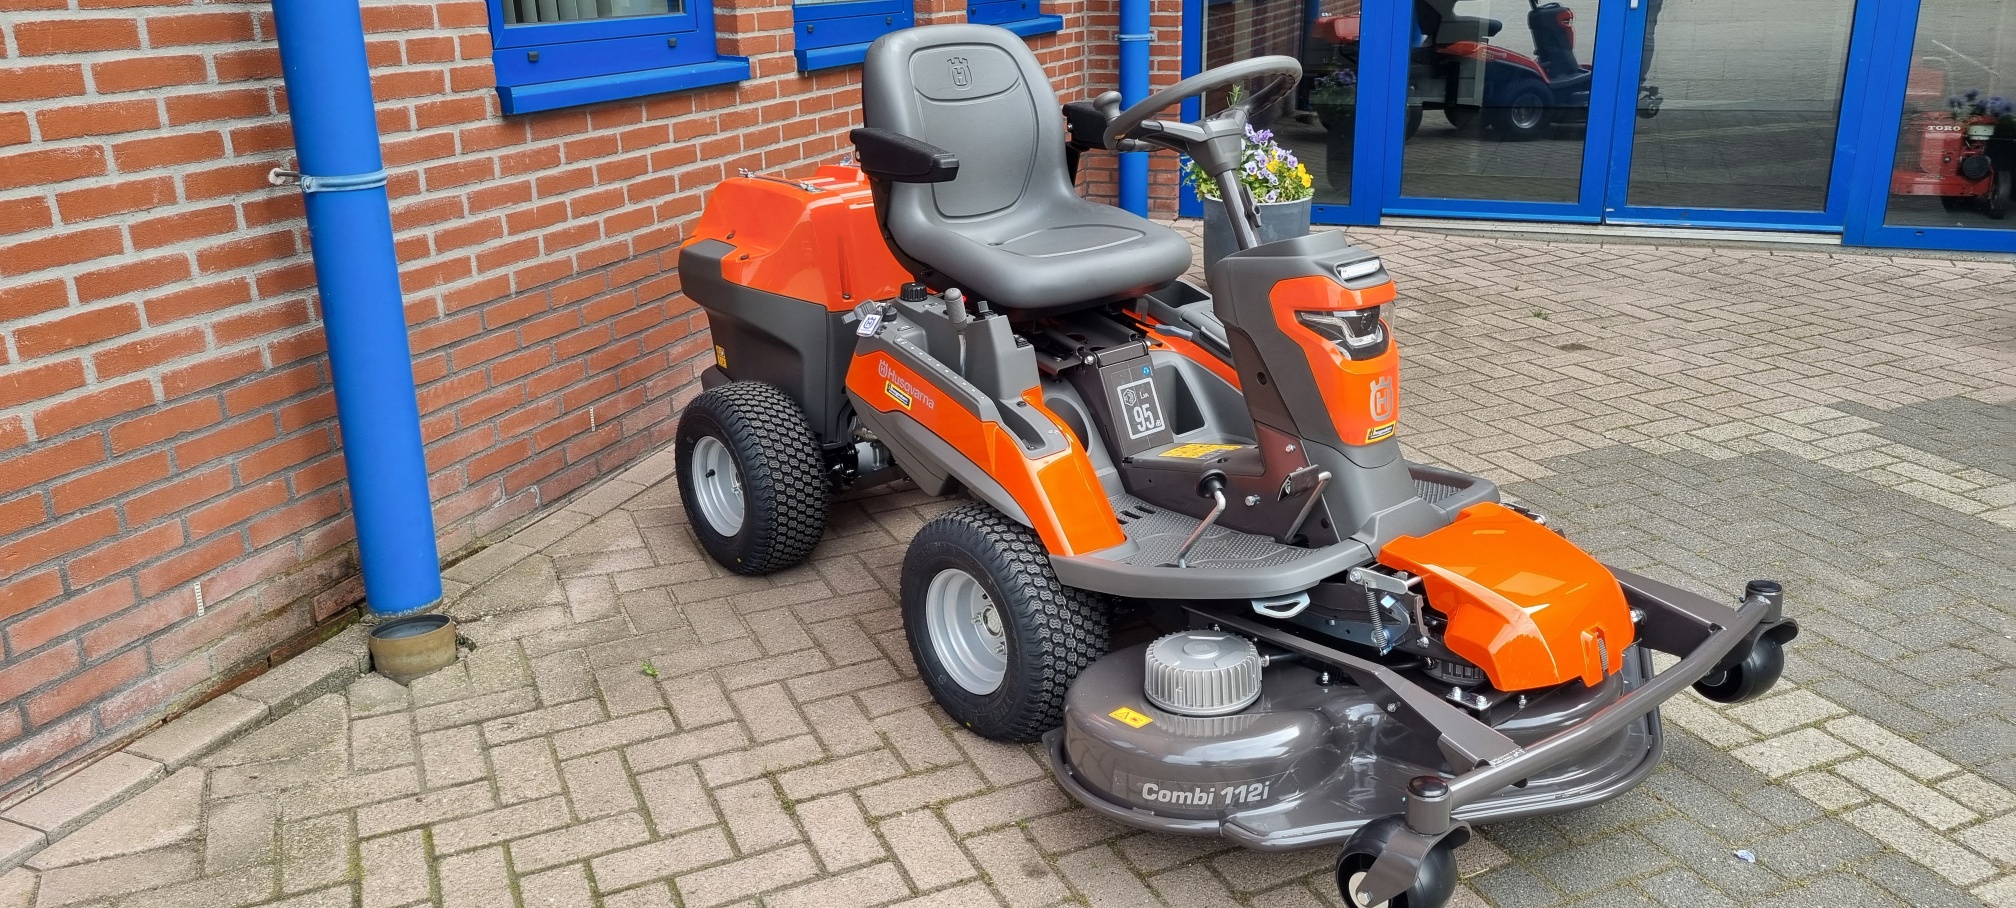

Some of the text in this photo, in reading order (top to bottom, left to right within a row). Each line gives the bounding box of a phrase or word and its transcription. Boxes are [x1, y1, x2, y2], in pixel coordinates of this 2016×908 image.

[888, 368, 934, 409] Husqvarna
[1134, 404, 1154, 431] 95
[1141, 780, 1271, 806] Combi 112i
